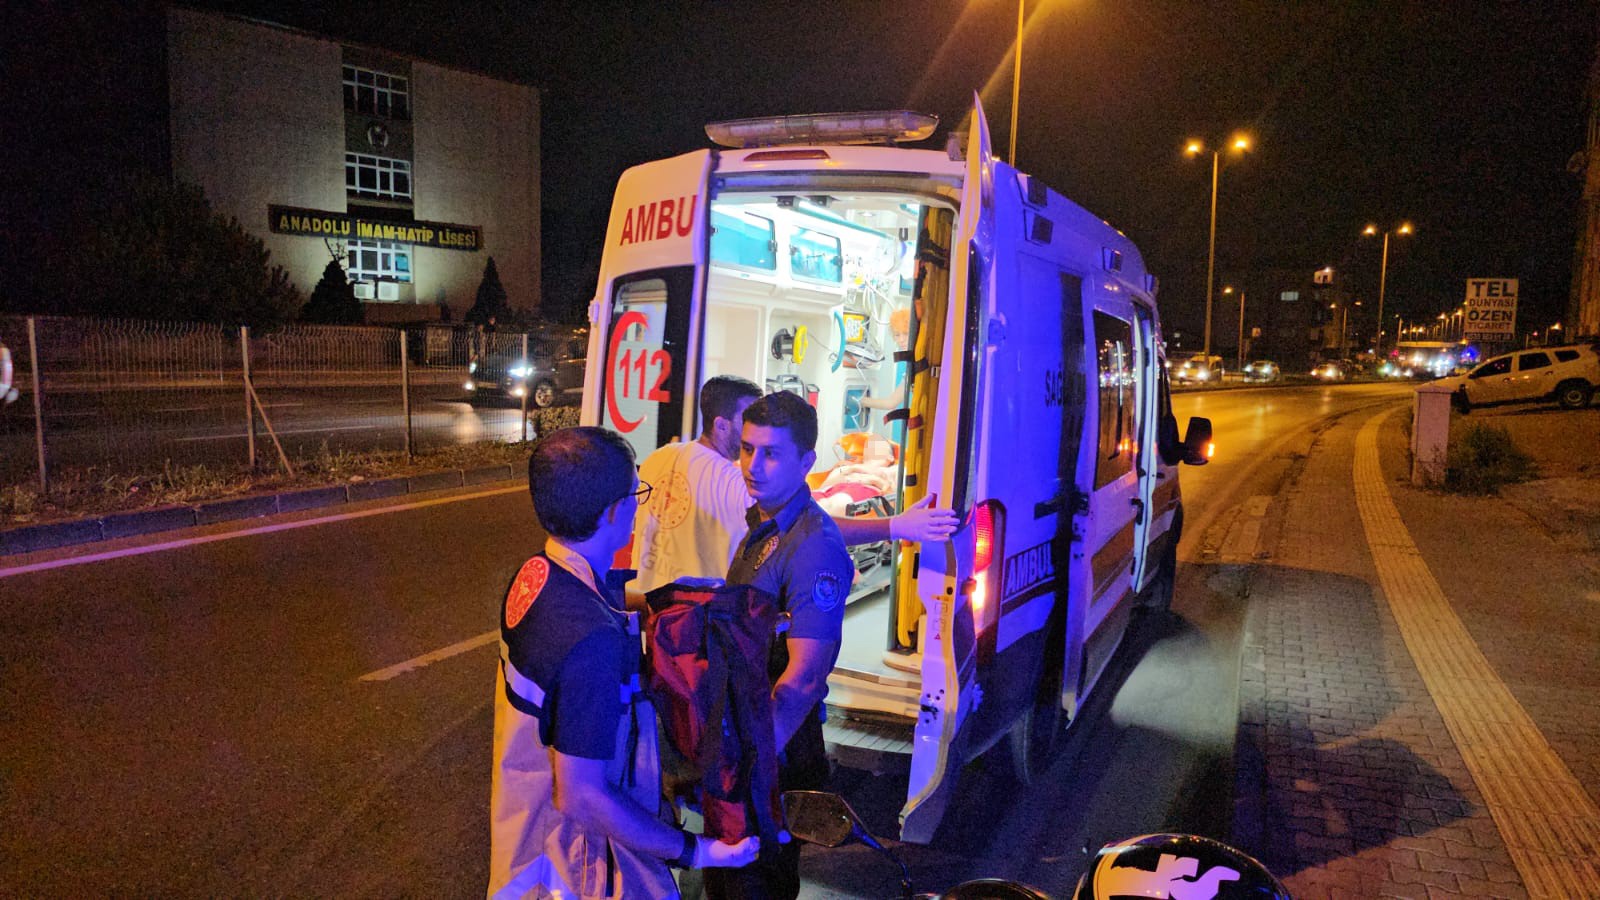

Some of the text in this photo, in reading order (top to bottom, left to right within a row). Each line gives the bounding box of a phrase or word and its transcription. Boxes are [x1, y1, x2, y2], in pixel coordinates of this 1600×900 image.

[279, 215, 476, 247] ANADOLU İMAM-HATİP LİSESİ
[620, 195, 698, 246] AMBU
[1471, 281, 1515, 297] TEL
[619, 348, 672, 404] 112
